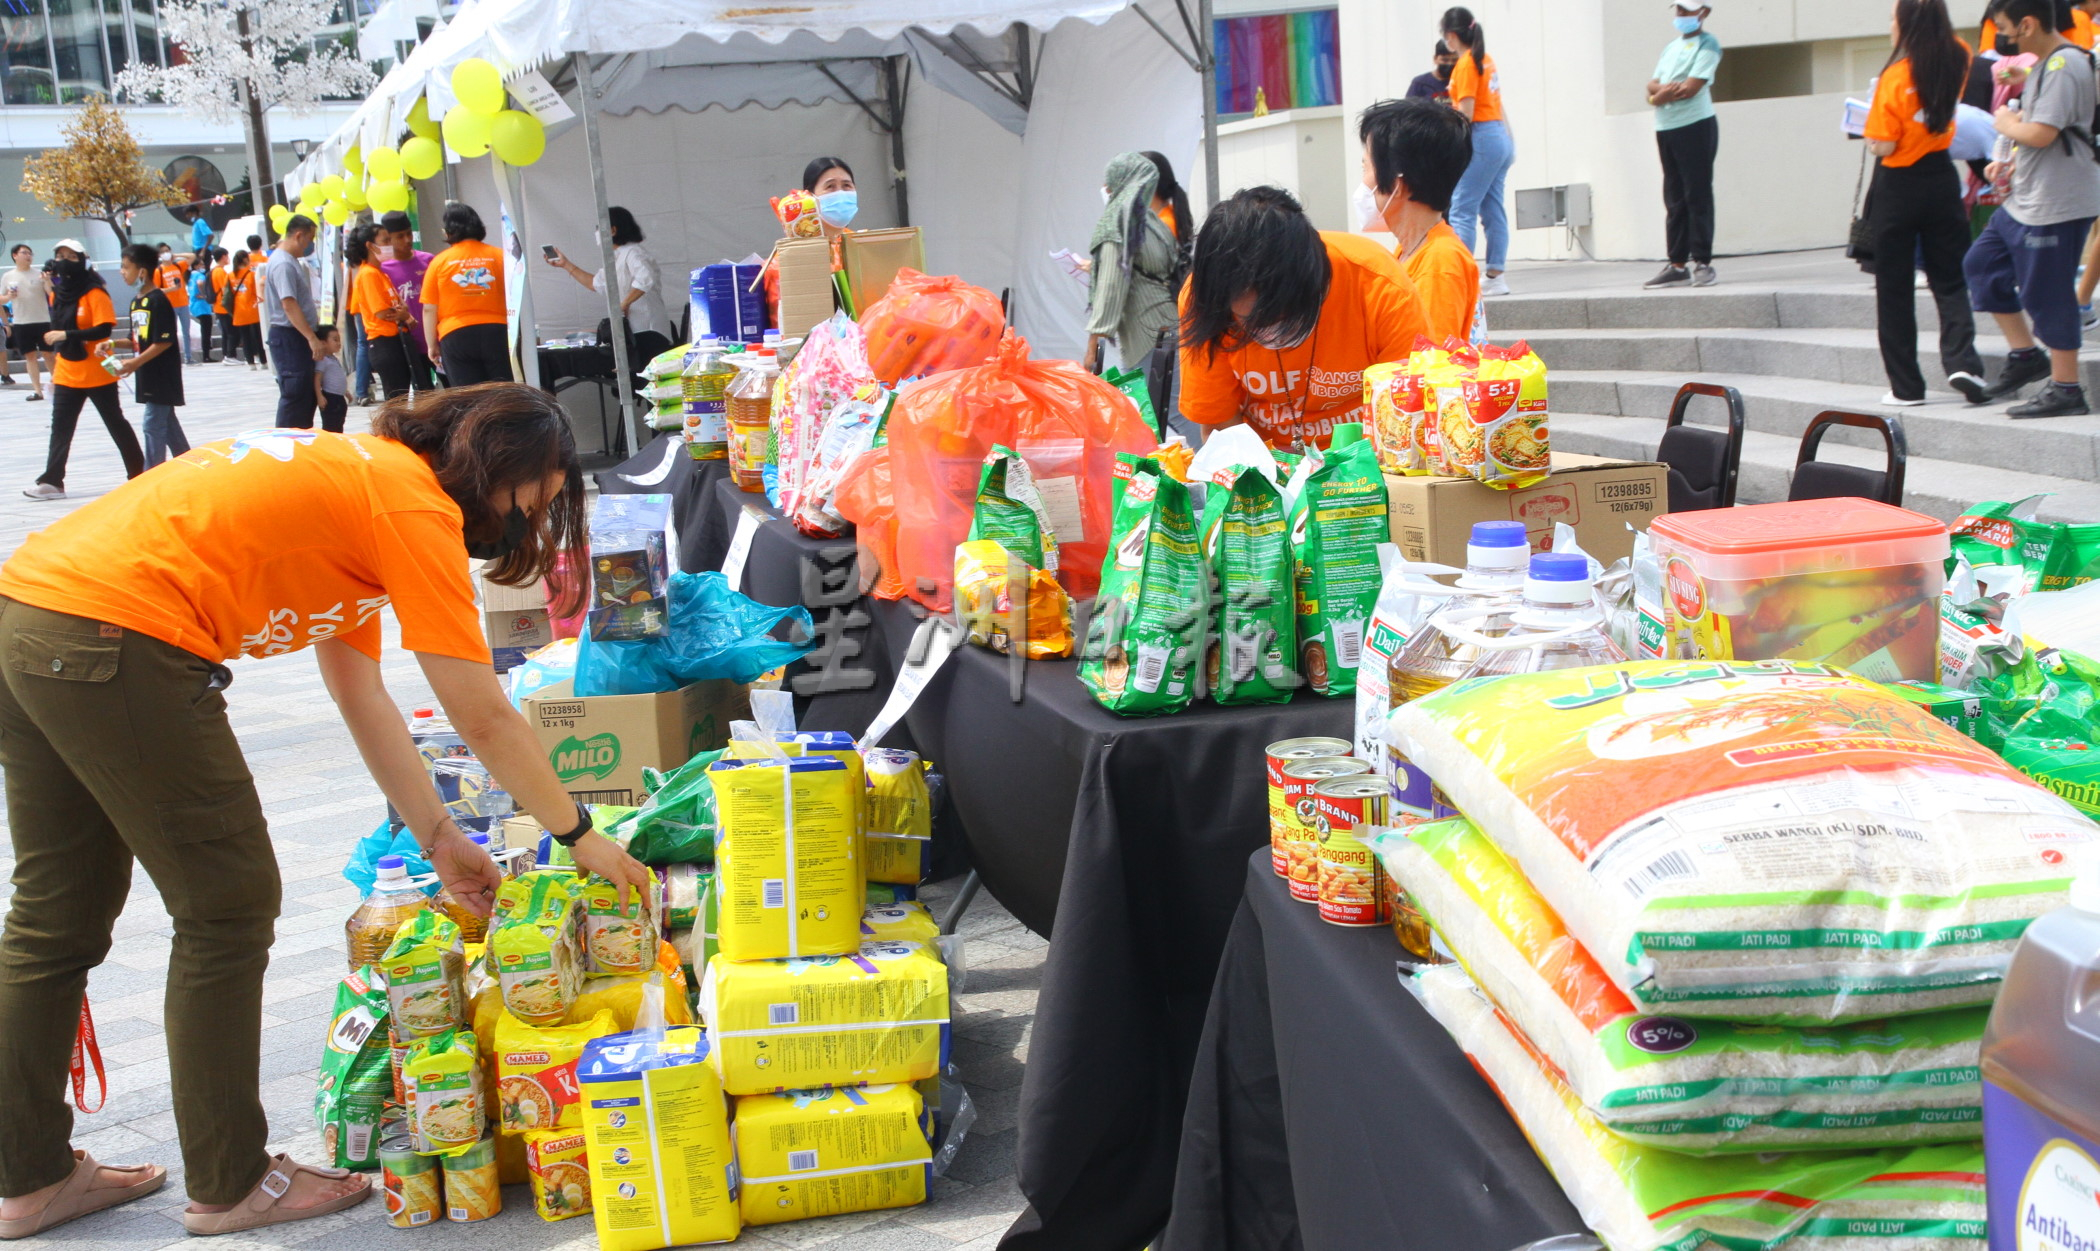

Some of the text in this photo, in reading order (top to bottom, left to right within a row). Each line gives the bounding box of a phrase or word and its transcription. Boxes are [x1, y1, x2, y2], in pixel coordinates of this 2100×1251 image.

[1489, 381, 1516, 396] 5+1
[1321, 477, 1368, 489] ENERGY TO
[1323, 483, 1378, 497] GO FURTHER
[1601, 482, 1652, 499] 12398895
[1610, 501, 1653, 514] 12(6x79g)
[1963, 518, 2010, 534] WAJAH
[2026, 542, 2049, 552] TEN
[1681, 581, 1700, 605] SING
[542, 705, 582, 715] 12238958
[542, 720, 551, 728] 12
[561, 719, 575, 728] 1kg
[557, 746, 615, 773] MILO
[1319, 799, 1360, 824] BRAND
[1723, 822, 1928, 844] SERBA WANGI (KL) SDN. BHD.
[1641, 934, 1696, 948] JATI PADI
[1740, 933, 1791, 946] JATI PADI
[1824, 932, 1882, 946] JATI PADI
[1950, 928, 1983, 942] PADI
[525, 955, 549, 964] Ayam
[415, 965, 439, 974] Ayam
[1642, 1027, 1685, 1044] 5%
[509, 1055, 546, 1063] MAMEE
[1924, 1069, 1978, 1085] JATI PADI
[1636, 1086, 1686, 1101] JATI PADI
[1822, 1115, 1850, 1127] PADI
[1921, 1110, 1976, 1122] JATI PADI
[549, 1136, 586, 1150] MAMEE
[1847, 1220, 1905, 1233] JATI PADI
[1955, 1222, 1985, 1235] PADI
